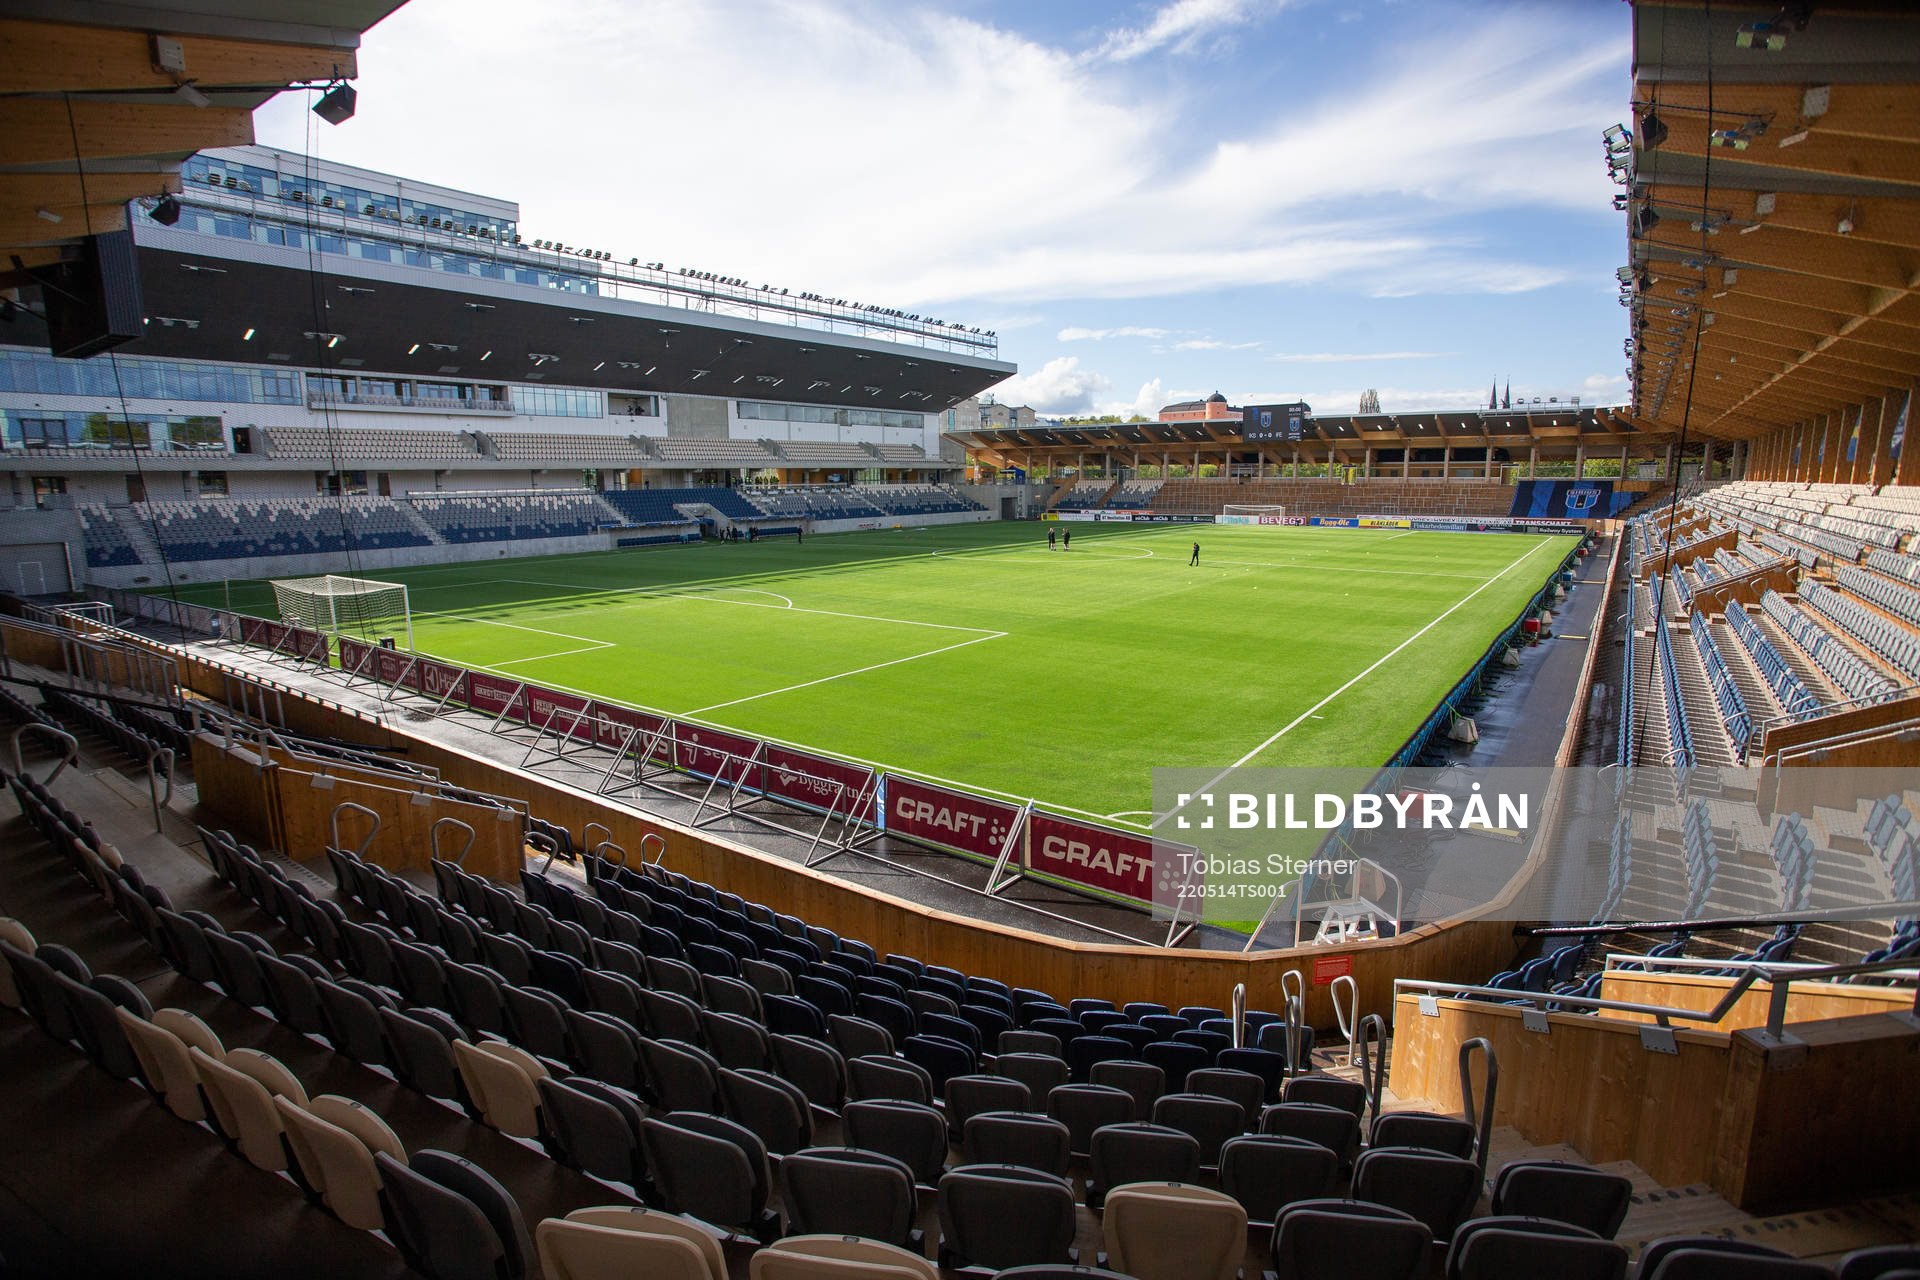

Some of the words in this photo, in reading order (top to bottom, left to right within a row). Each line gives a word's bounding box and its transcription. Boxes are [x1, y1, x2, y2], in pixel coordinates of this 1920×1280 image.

[1260, 516, 1304, 525] BEVEGO
[897, 796, 985, 838] CRAFT
[1043, 835, 1156, 882] CRAFT
